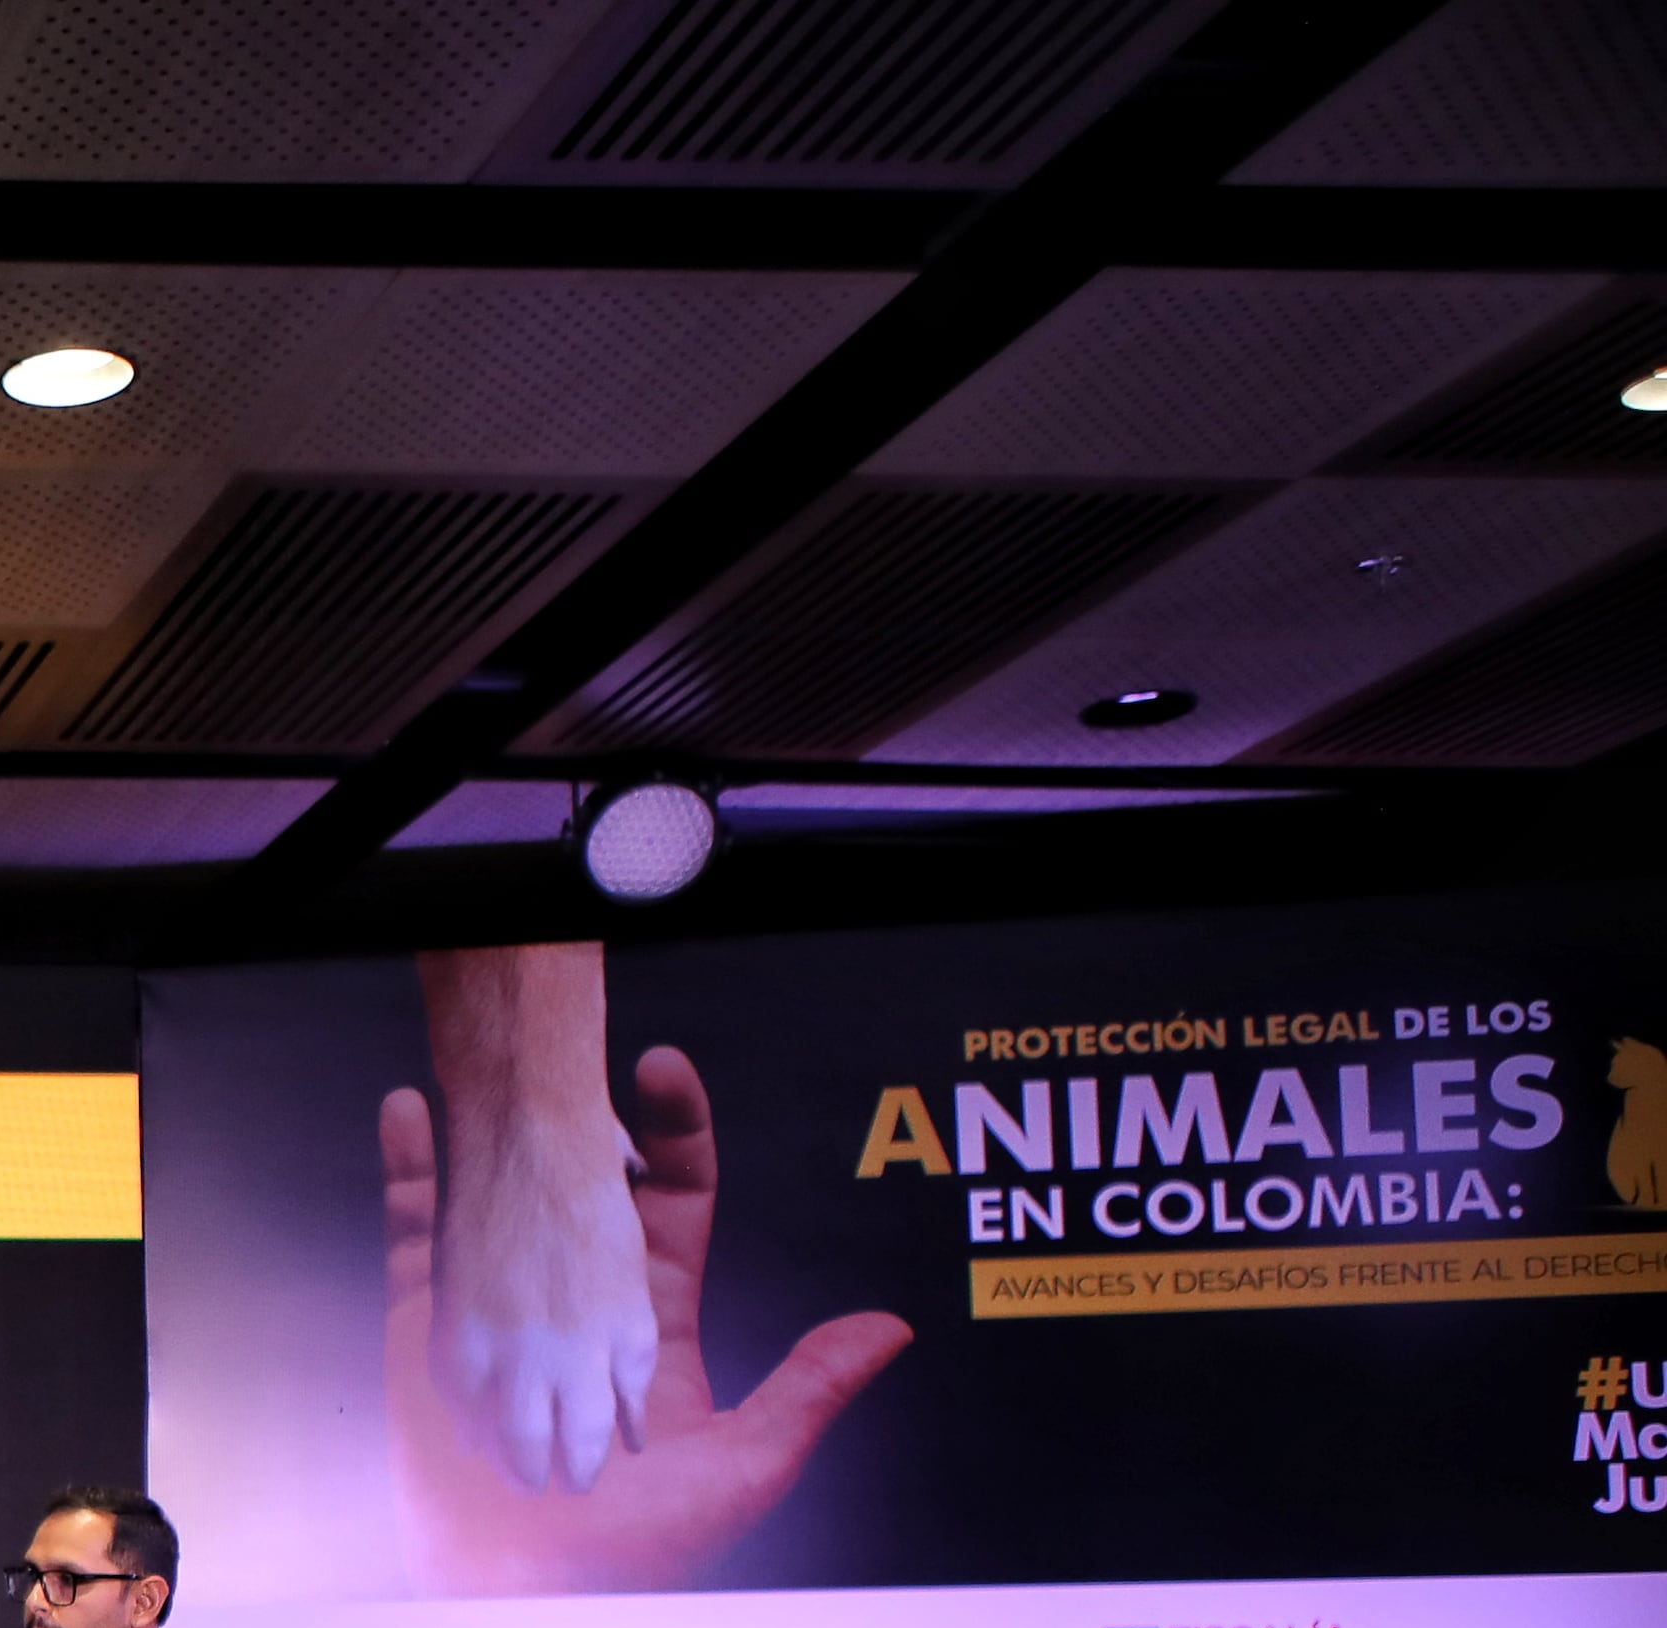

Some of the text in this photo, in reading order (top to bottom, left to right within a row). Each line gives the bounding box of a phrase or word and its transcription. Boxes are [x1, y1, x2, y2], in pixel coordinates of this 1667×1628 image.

[964, 1000, 1553, 1062] PROTECCIÓN LEGAL DE LOS
[855, 1054, 1564, 1179] ANIMALES
[968, 1169, 1525, 1243] EN COLOMBIA:
[991, 1251, 1667, 1302] AVANCES Y DESAFÍOS FRENTE AL DERECH
